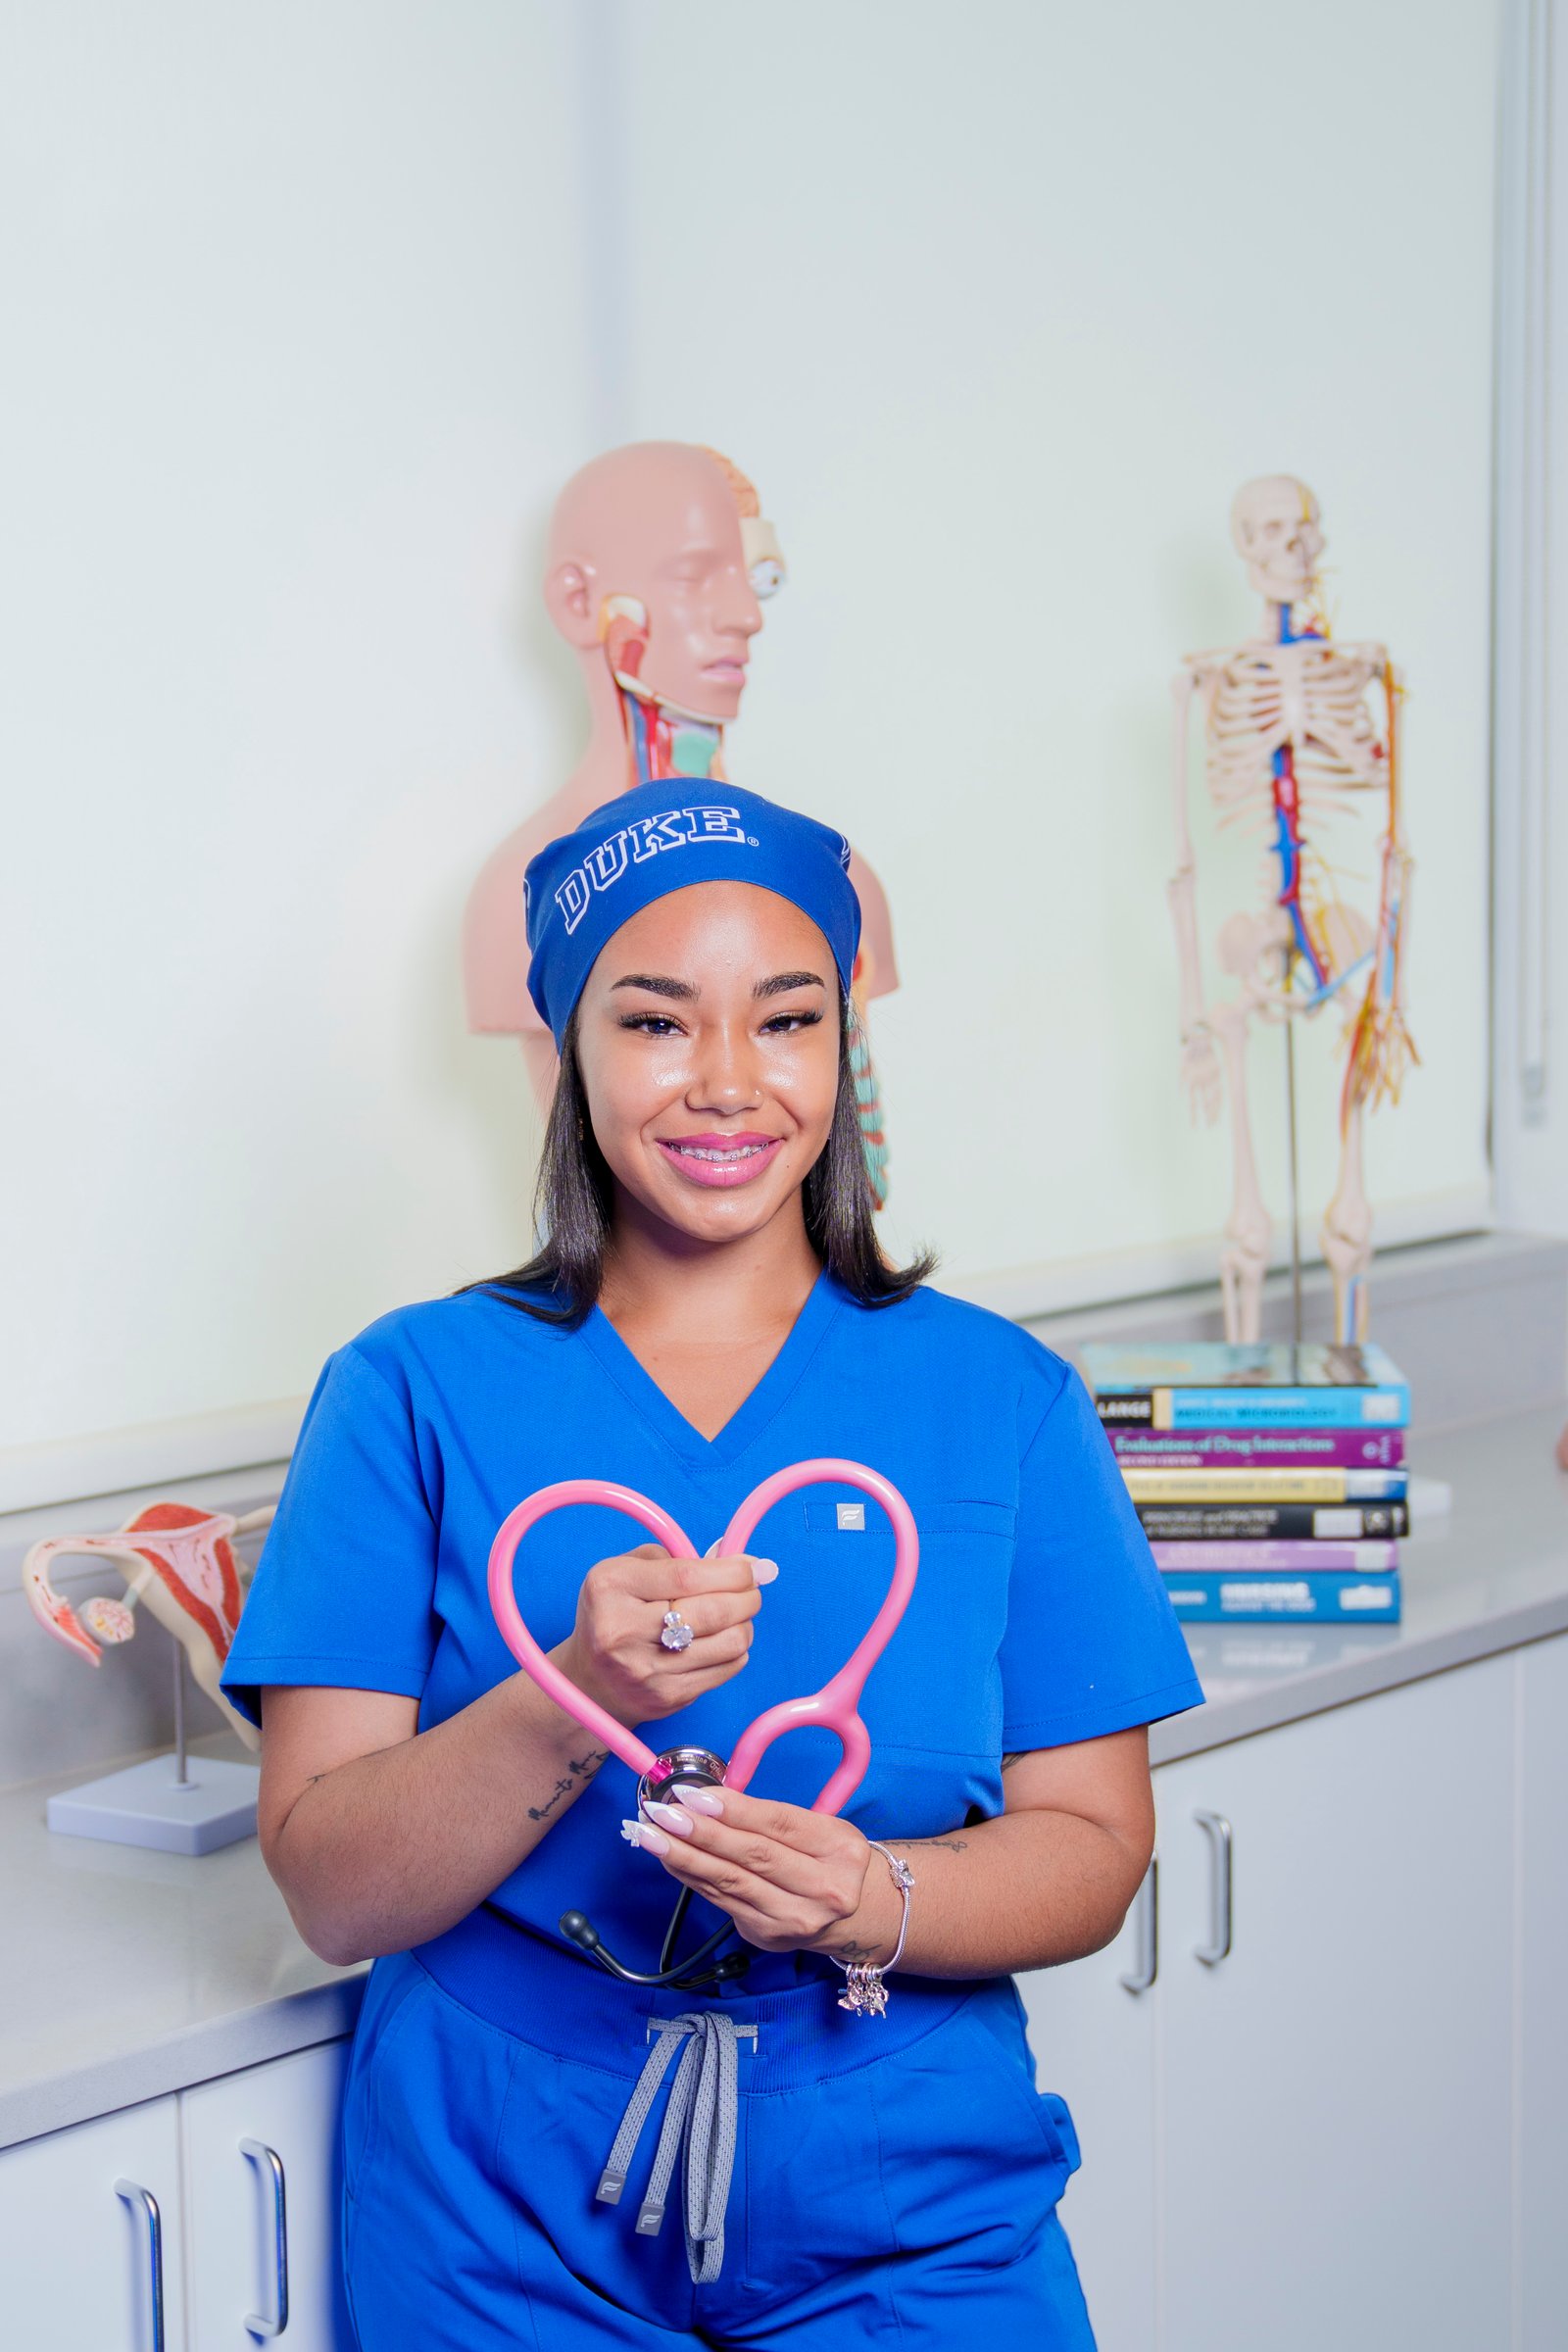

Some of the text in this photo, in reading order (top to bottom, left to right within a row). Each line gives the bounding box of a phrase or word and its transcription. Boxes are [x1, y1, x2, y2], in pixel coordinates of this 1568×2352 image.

[555, 807, 745, 935] DUKE
[1097, 1401, 1151, 1418] LANGE
[1213, 1436, 1251, 1455] Drug
[1253, 1436, 1335, 1451] Interactions
